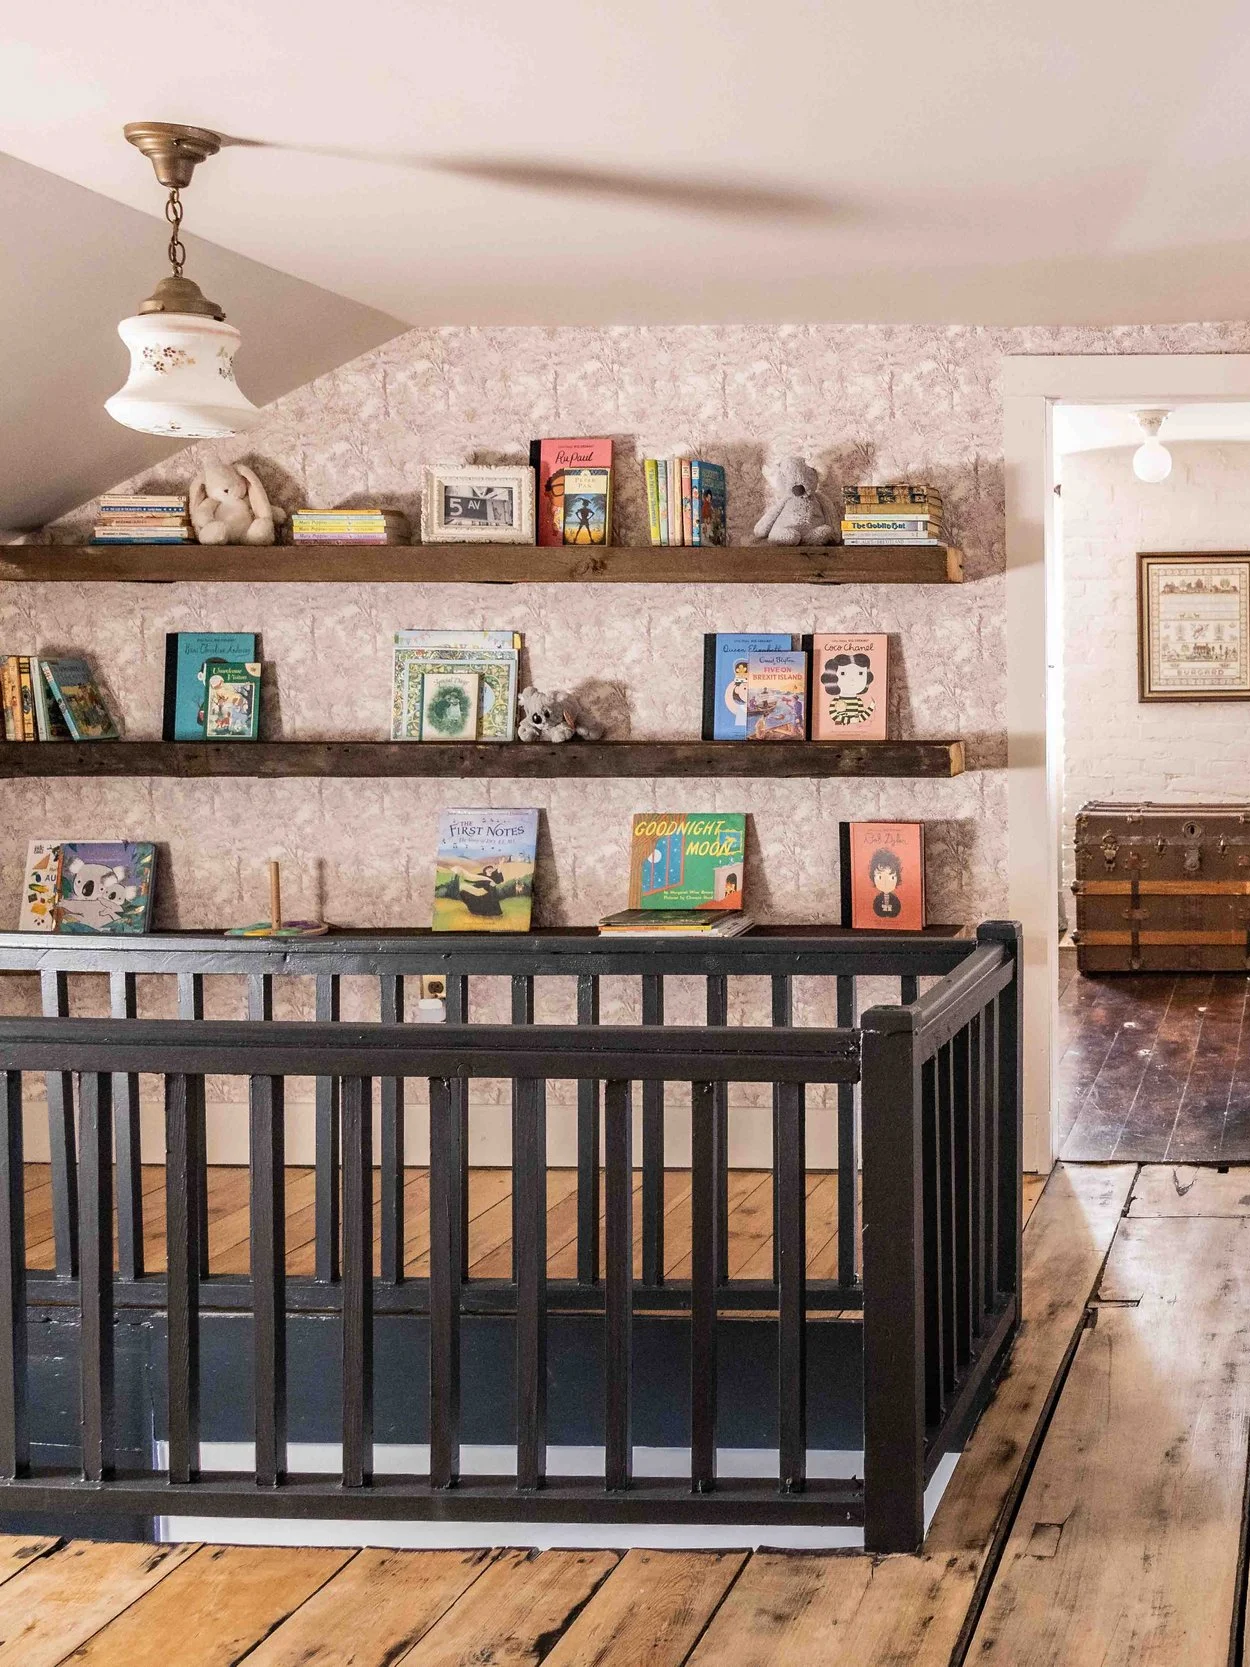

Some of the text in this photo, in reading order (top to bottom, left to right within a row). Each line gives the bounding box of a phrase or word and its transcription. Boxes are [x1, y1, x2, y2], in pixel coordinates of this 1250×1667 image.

[450, 498, 480, 516] 5 AV
[723, 644, 745, 652] Queen
[844, 643, 874, 651] Chanel
[449, 822, 525, 837] FIRST NOTES
[634, 821, 725, 836] GOODNIGHT
[686, 841, 733, 856] MOON
